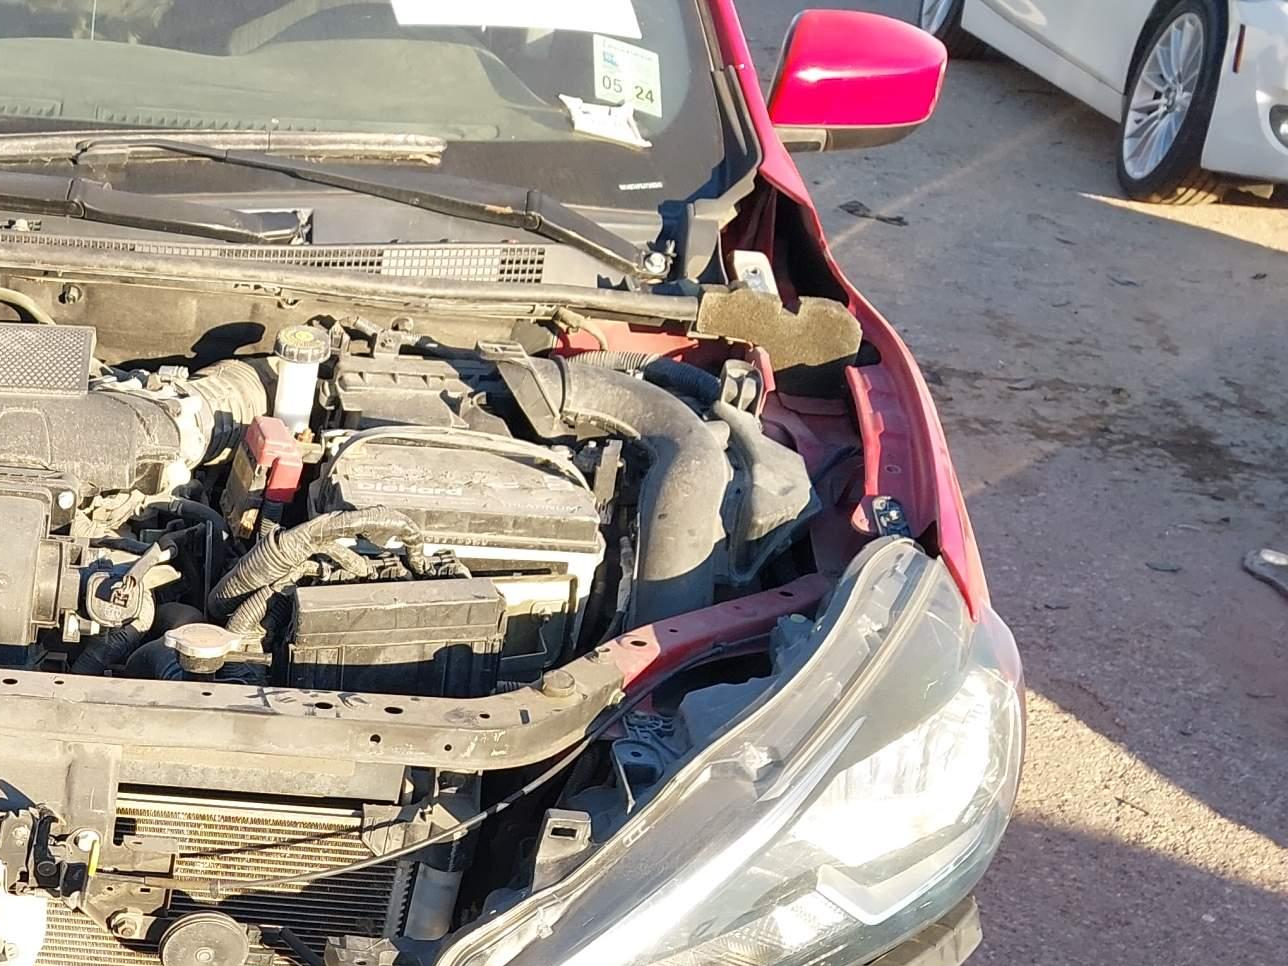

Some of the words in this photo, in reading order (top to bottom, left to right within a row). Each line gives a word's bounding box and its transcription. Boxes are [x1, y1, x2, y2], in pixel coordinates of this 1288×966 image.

[602, 75, 623, 93] 05
[634, 85, 655, 104] 24
[357, 482, 463, 496] DieHard
